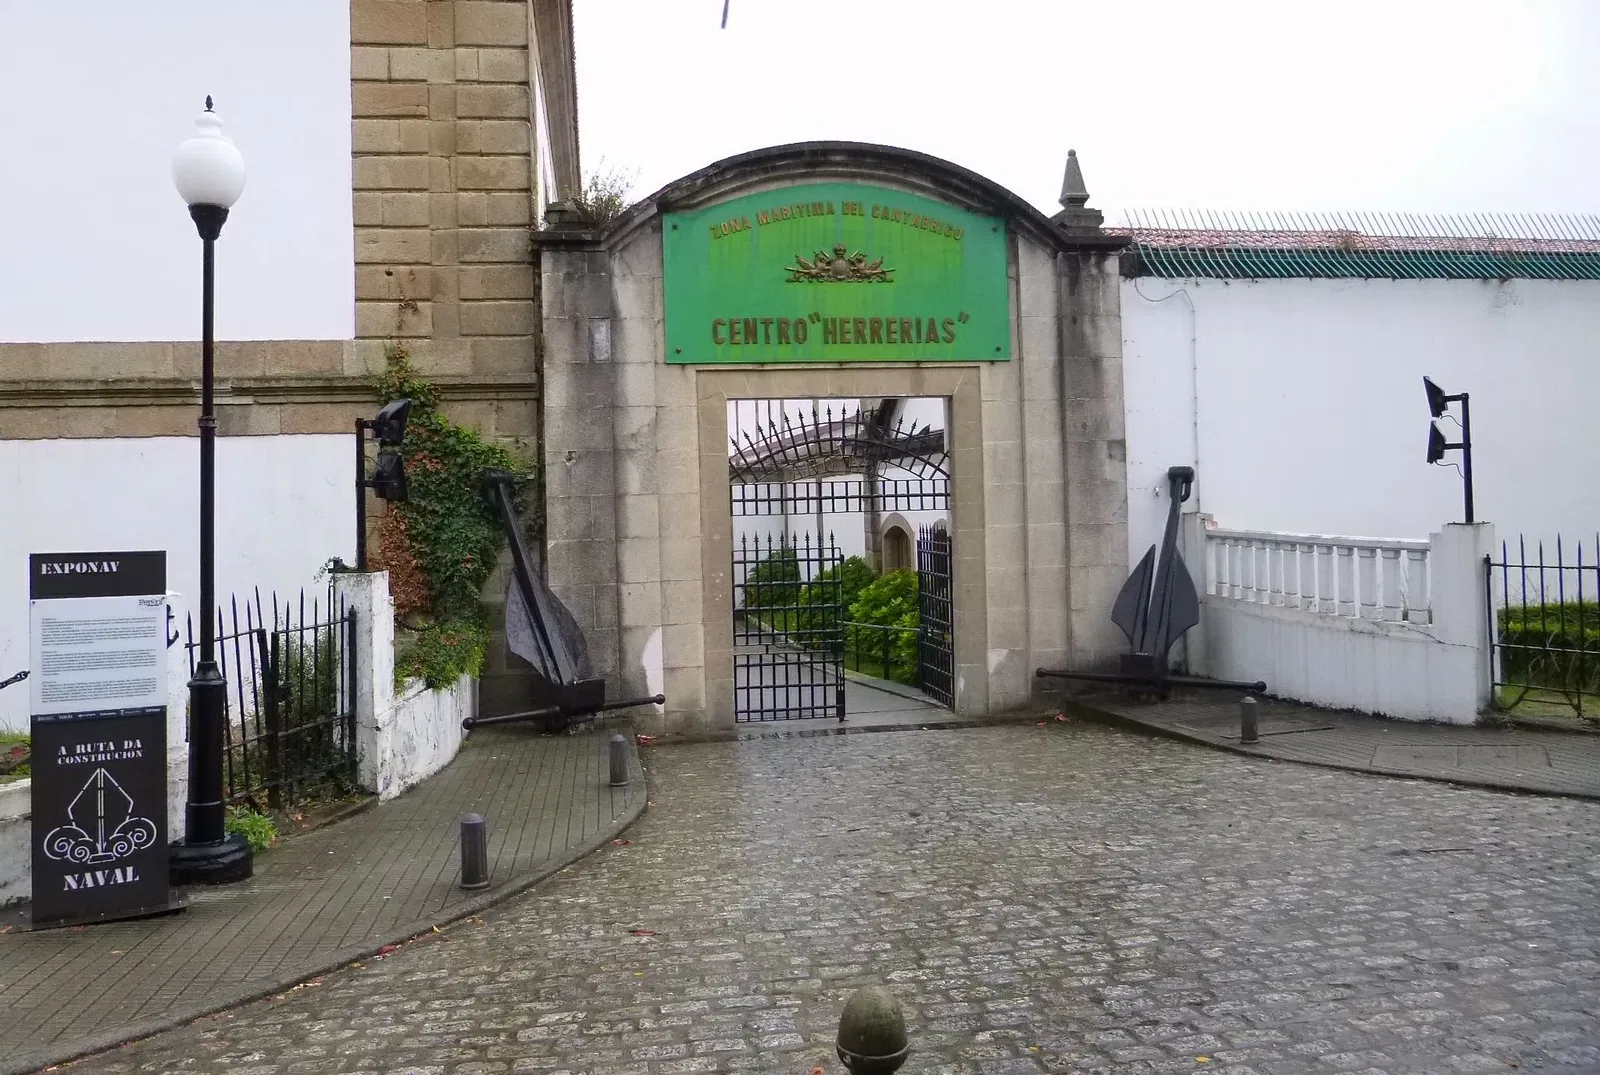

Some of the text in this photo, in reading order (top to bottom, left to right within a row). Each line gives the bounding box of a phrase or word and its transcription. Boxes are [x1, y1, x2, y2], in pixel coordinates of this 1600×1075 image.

[710, 200, 964, 240] ZONA MARITIMA DEL CANTABRICO
[712, 317, 808, 345] CENTRO
[41, 561, 119, 575] EXPONAV
[58, 739, 142, 756] A RUTA DA
[63, 866, 140, 891] NAVAL
